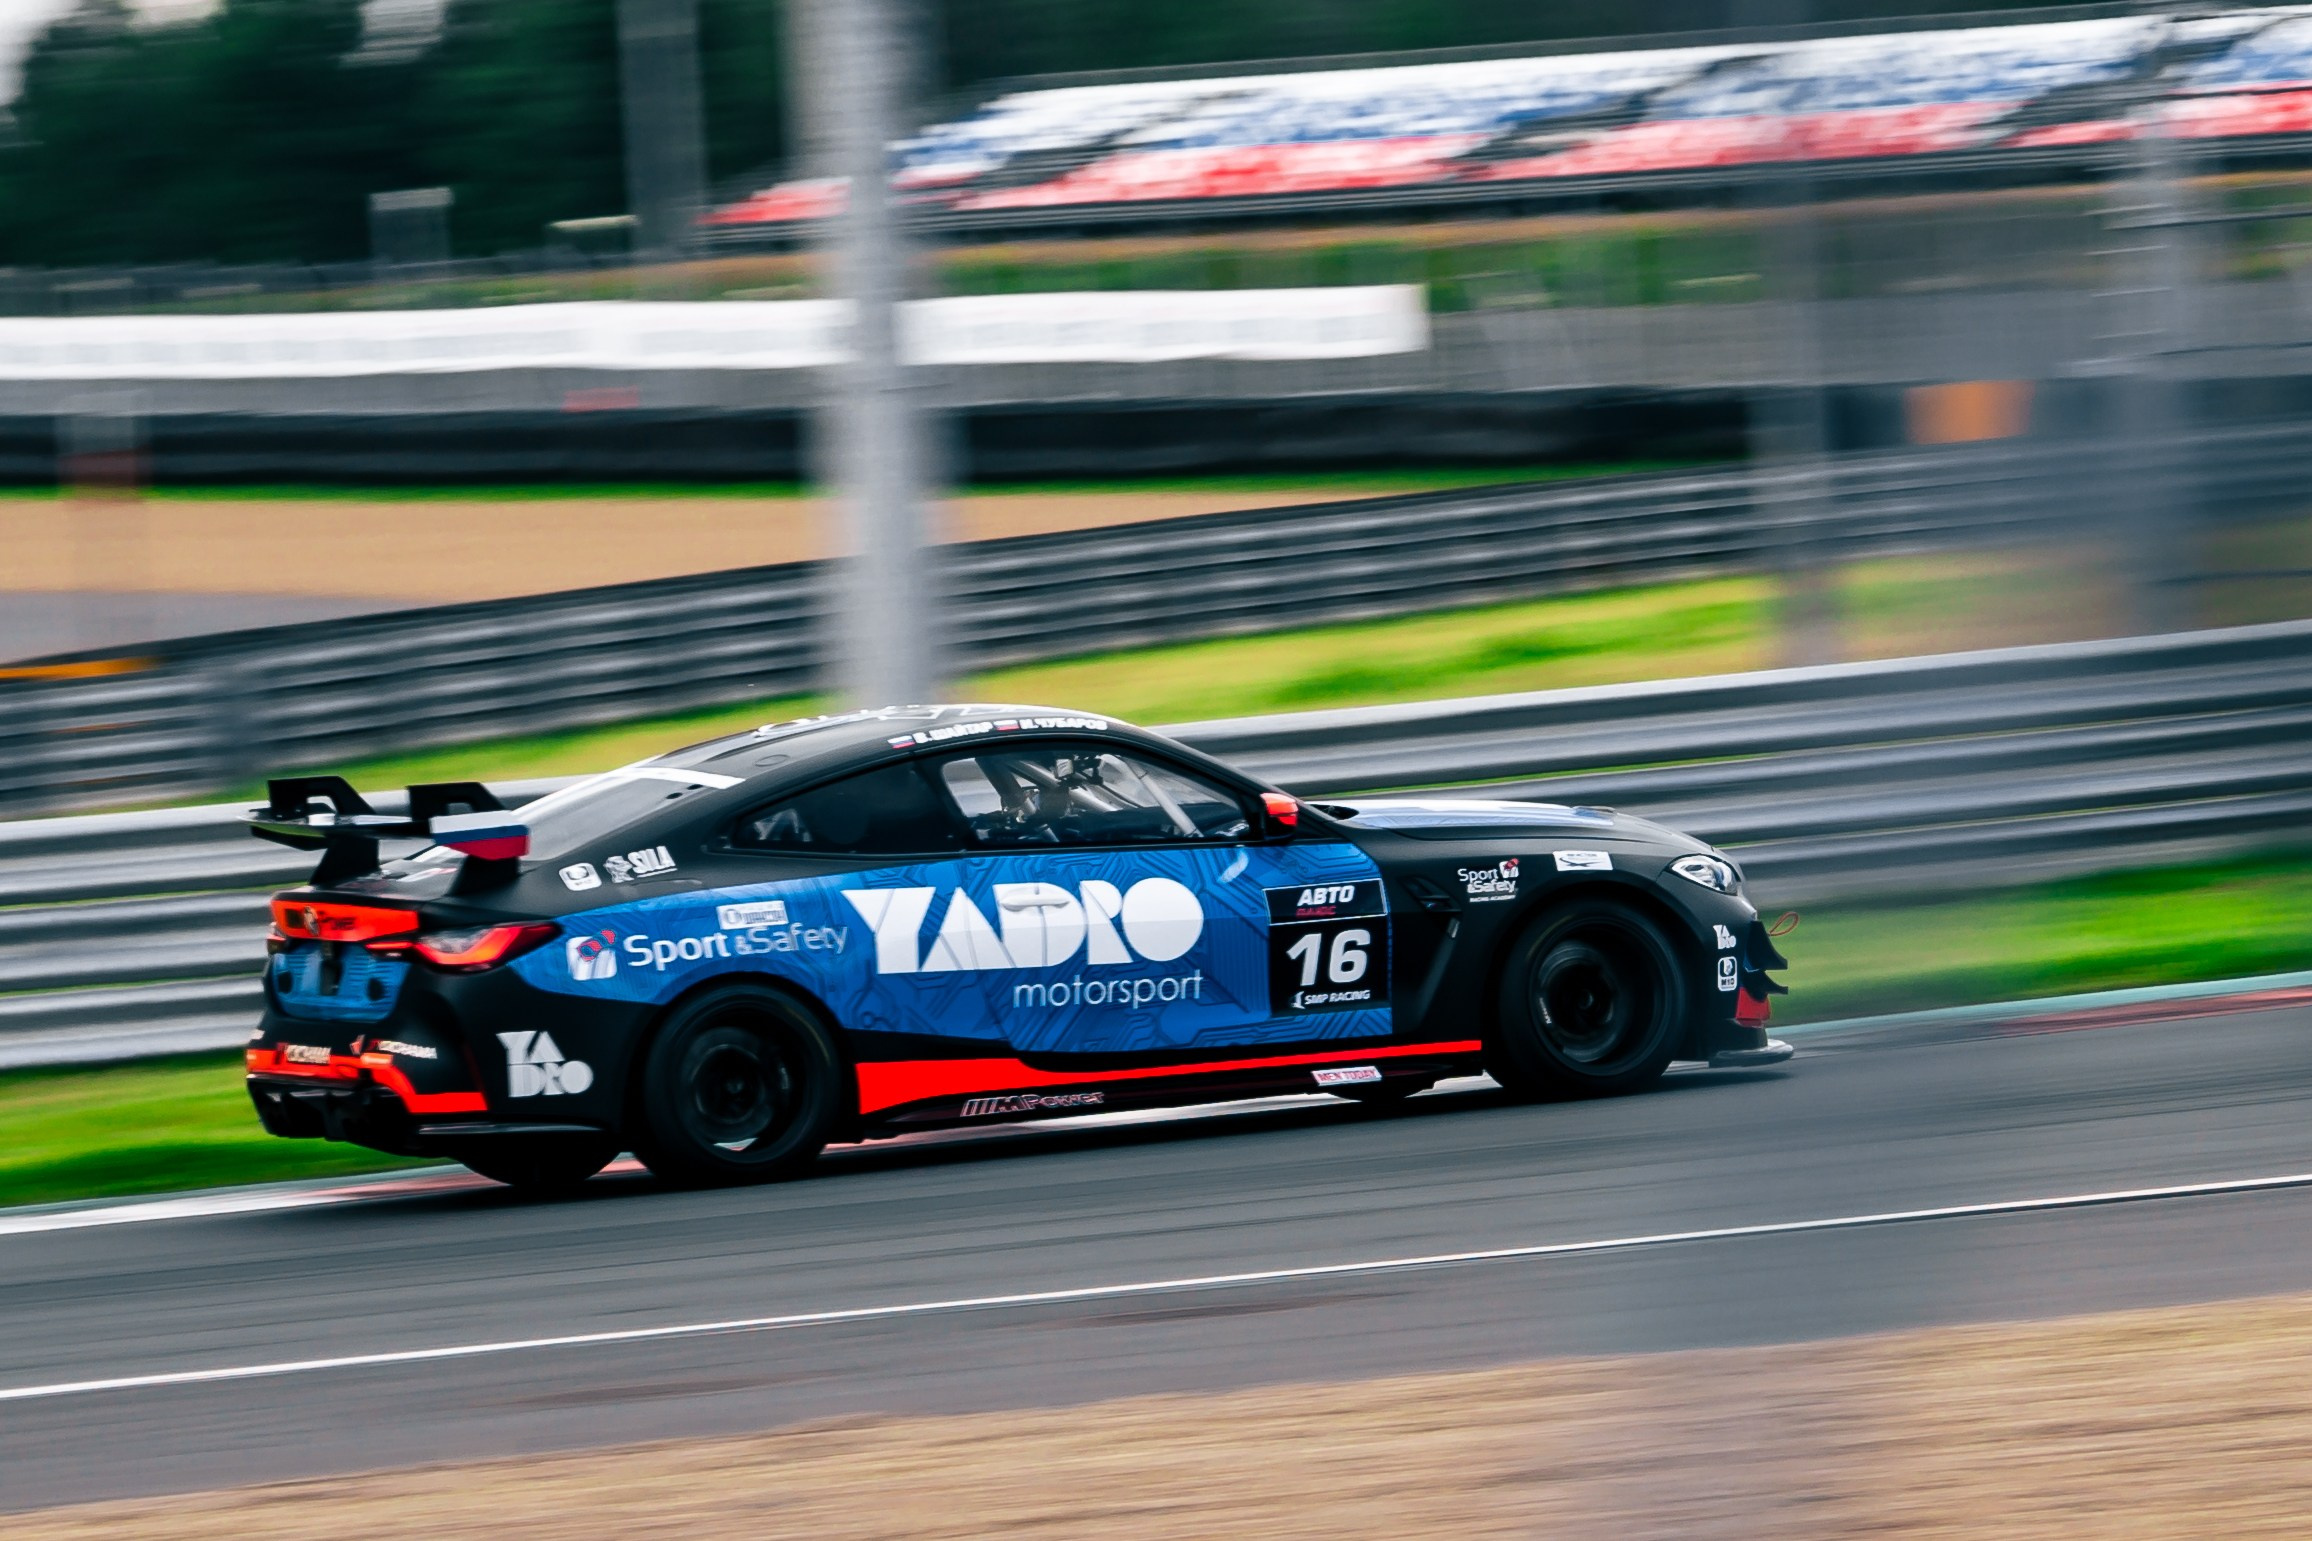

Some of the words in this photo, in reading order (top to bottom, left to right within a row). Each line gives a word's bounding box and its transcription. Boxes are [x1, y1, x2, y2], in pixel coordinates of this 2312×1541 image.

[1457, 868, 1499, 884] Sport
[841, 877, 1203, 974] YADRO
[622, 932, 732, 972] Sport
[1286, 929, 1371, 986] 16
[1013, 969, 1203, 1009] motorsport
[1304, 994, 1328, 1005] SMP
[1329, 990, 1370, 1003] RACING
